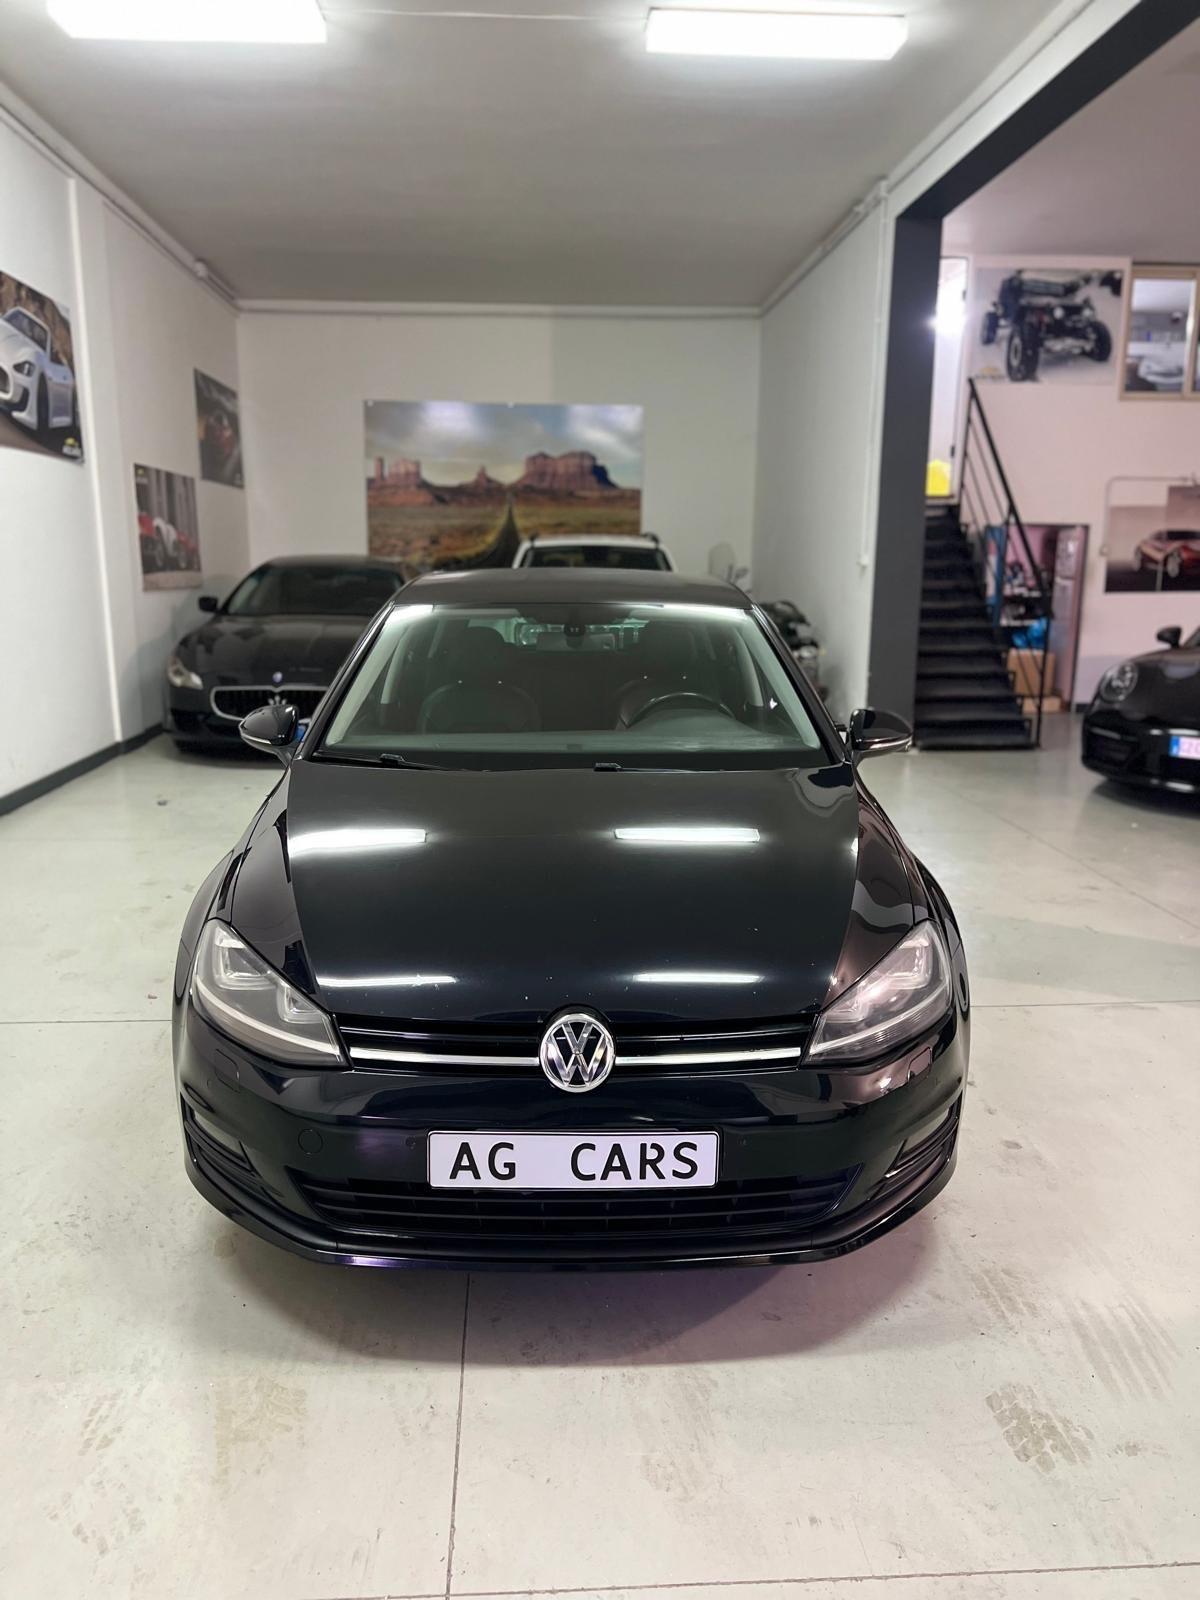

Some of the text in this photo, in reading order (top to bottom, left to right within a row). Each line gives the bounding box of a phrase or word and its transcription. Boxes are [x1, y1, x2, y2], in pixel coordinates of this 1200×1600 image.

[545, 1018, 610, 1089] VW
[449, 1141, 698, 1181] AG CARS
